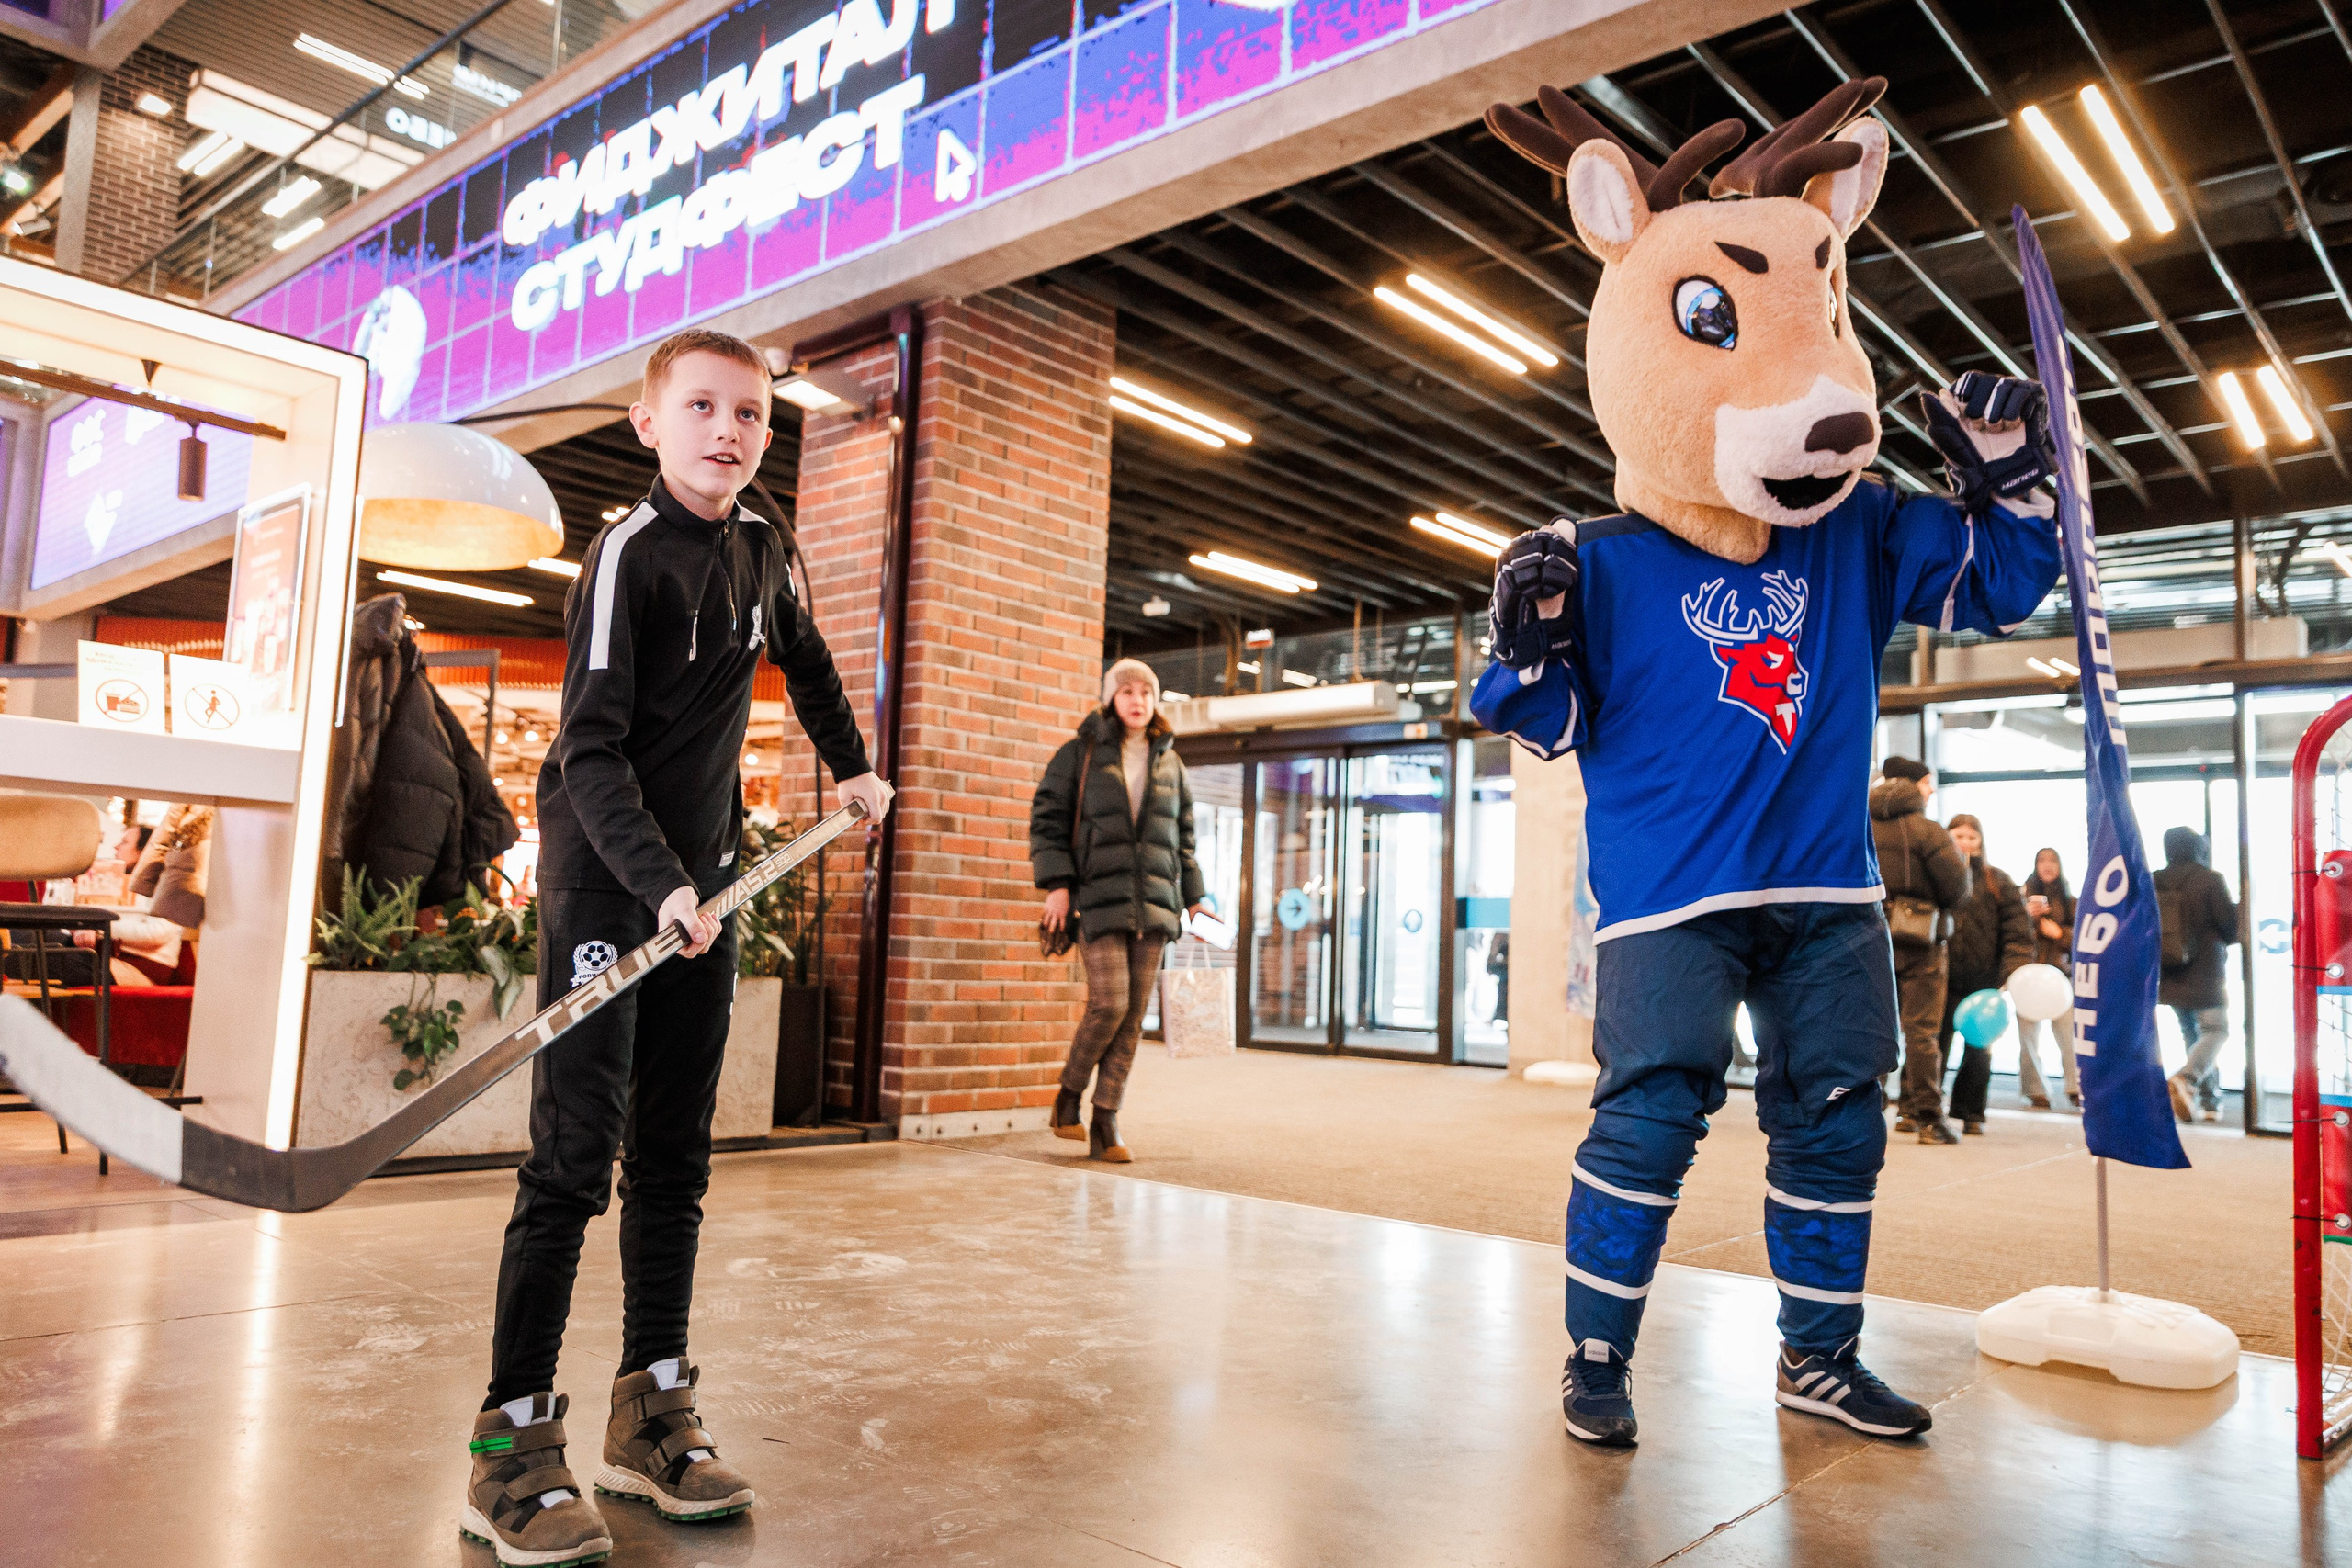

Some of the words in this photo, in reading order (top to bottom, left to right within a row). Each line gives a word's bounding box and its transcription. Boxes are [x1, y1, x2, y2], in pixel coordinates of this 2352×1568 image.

[511, 73, 926, 331] СТУДФЕСТ
[514, 924, 684, 1044] TRUE
[2074, 855, 2130, 1057] НЕБО
